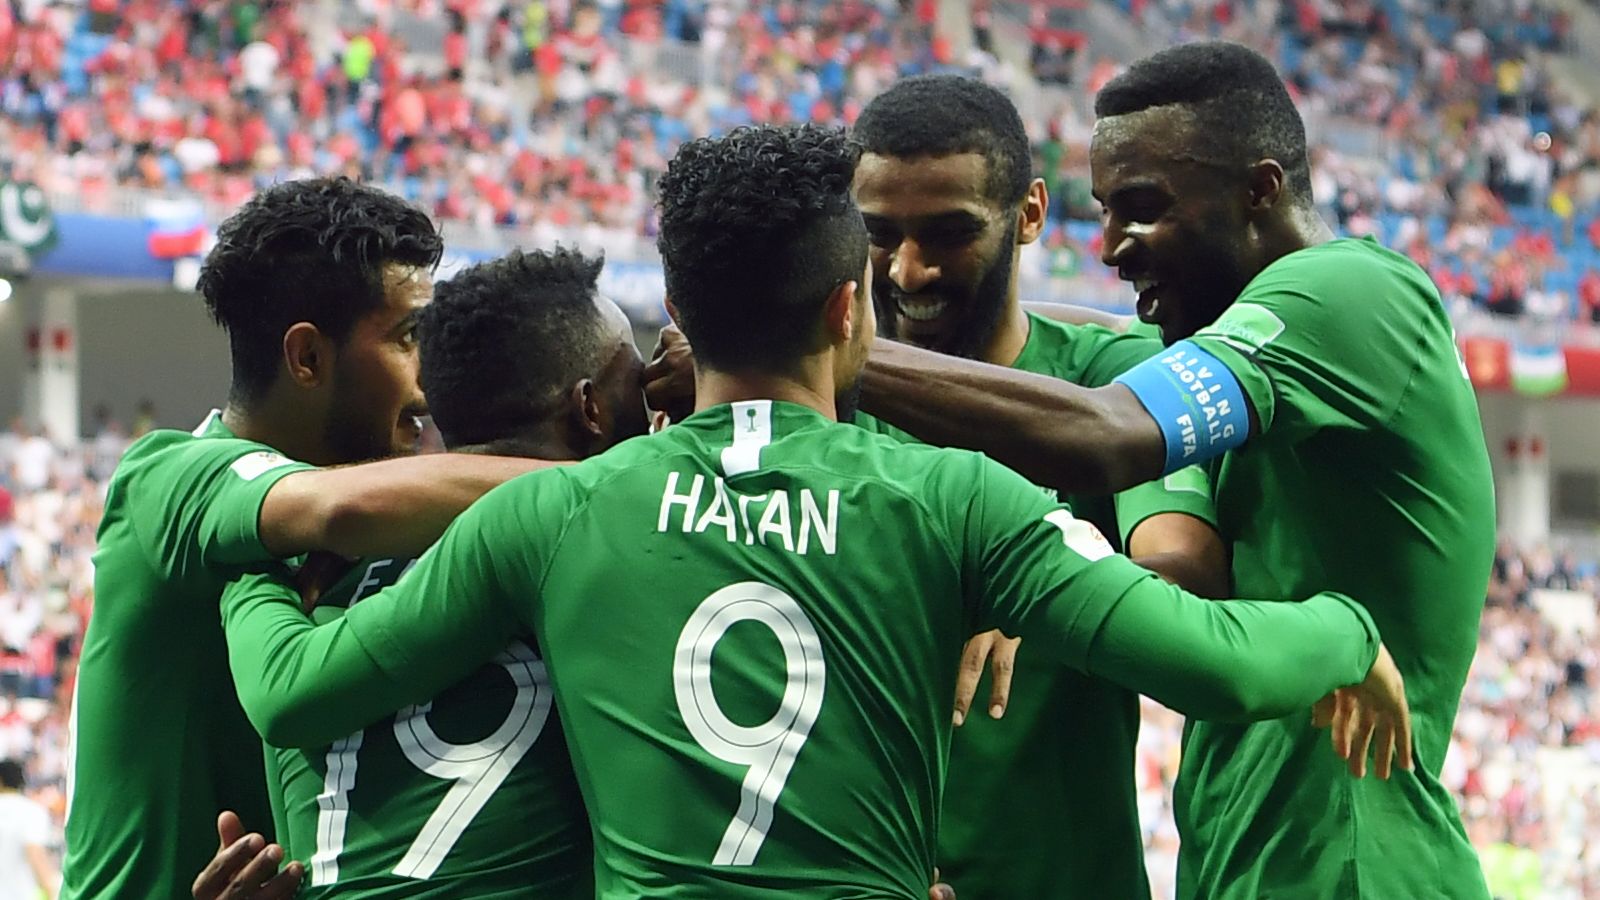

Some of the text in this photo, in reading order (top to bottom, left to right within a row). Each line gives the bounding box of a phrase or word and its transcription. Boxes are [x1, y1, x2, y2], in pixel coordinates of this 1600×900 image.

[1161, 355, 1222, 446] FOOTBALL
[1172, 350, 1235, 439] LIVING
[1176, 413, 1197, 458] FIFA
[658, 471, 840, 555] HATAN
[311, 640, 553, 887] 19
[673, 581, 826, 866] 9
